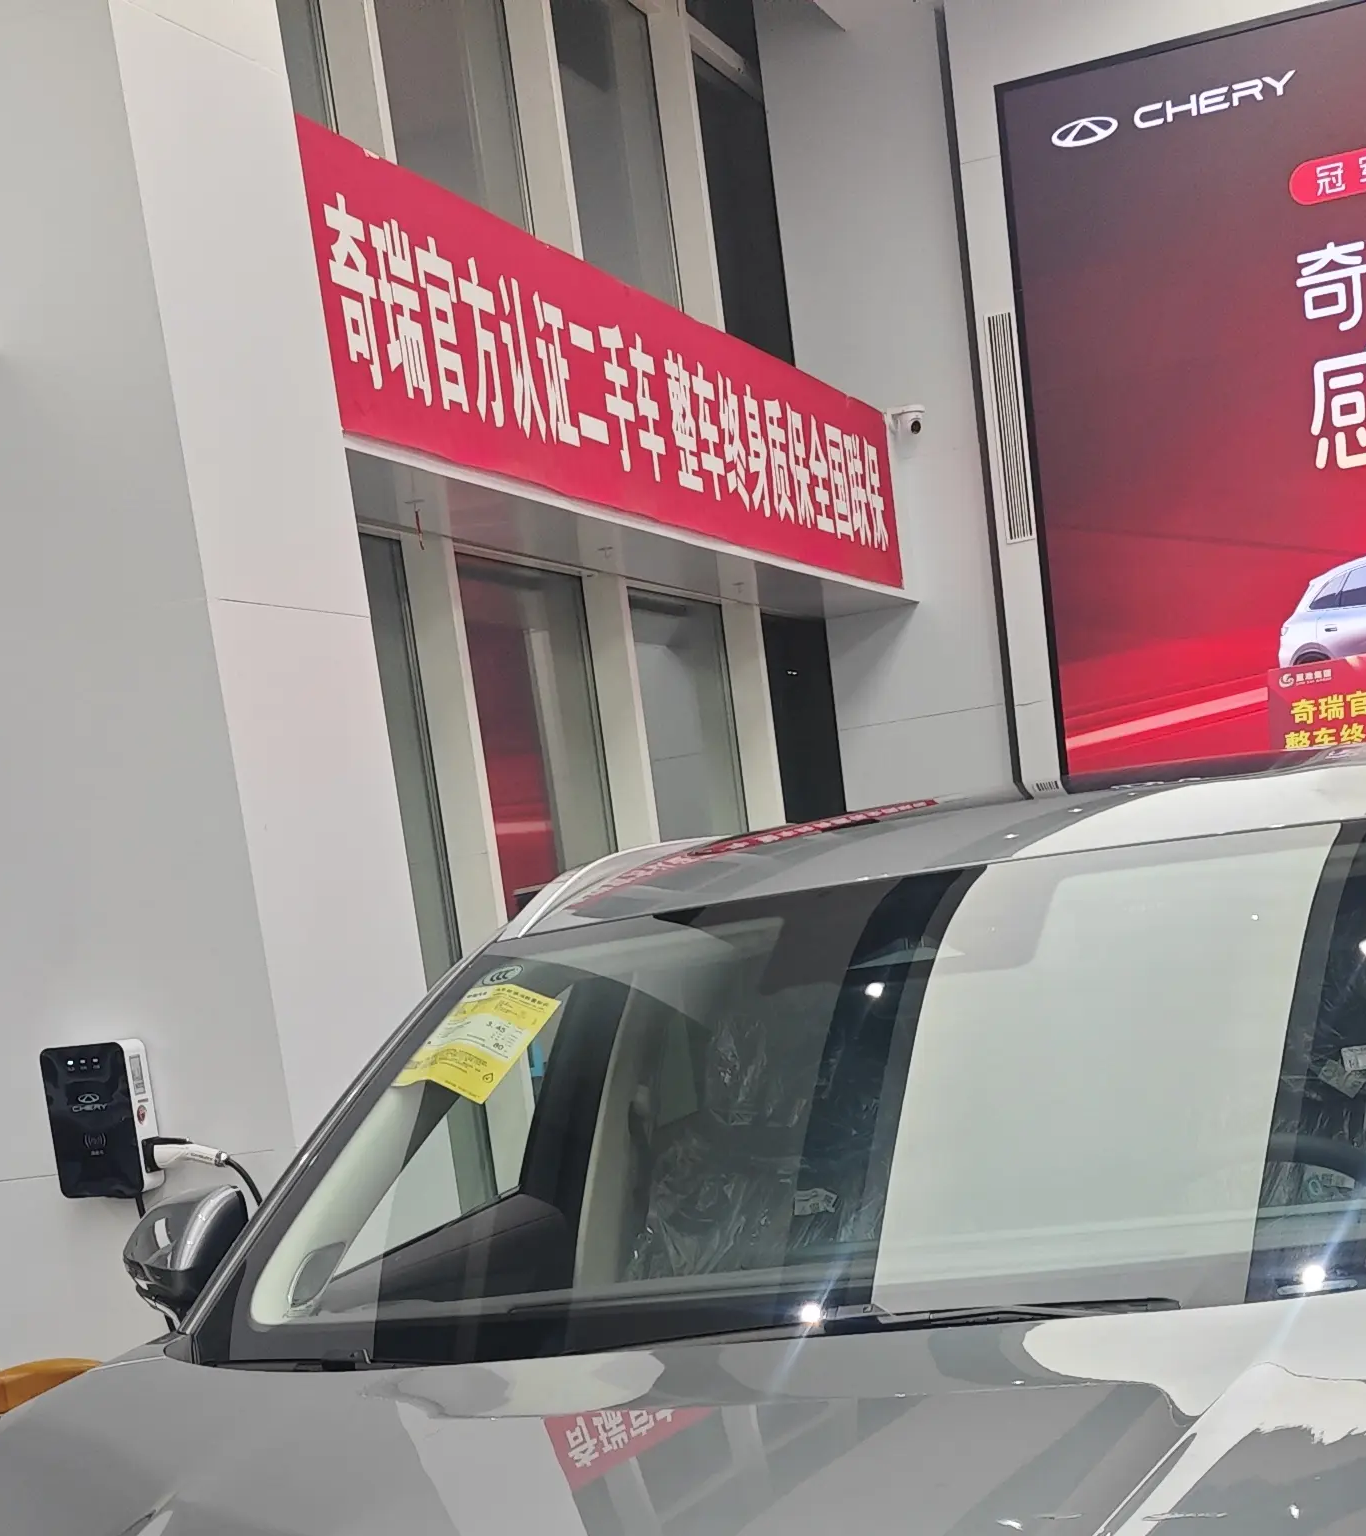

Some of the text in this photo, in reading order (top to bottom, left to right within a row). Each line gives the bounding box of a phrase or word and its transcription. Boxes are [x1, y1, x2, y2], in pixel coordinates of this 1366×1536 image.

[1133, 69, 1296, 130] CHERY
[323, 193, 889, 552] 奇瑞官方认证二手车 整车终身质保全国联保
